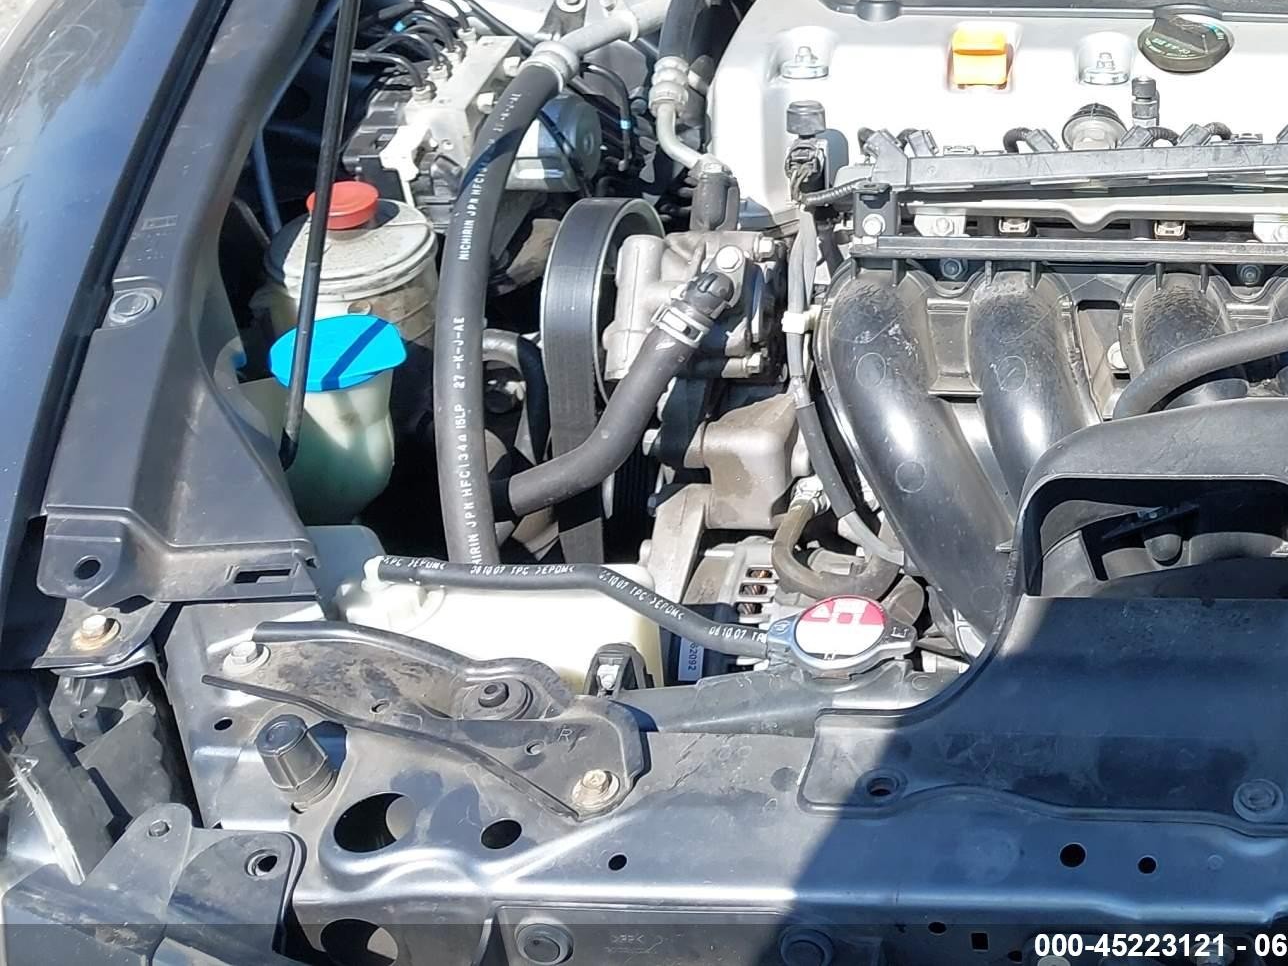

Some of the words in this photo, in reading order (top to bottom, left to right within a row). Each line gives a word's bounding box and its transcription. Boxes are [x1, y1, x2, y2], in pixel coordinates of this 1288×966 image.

[458, 219, 475, 261] NICHIRIN
[467, 197, 478, 217] JPN
[453, 374, 465, 389] 27
[463, 501, 477, 528] JPN
